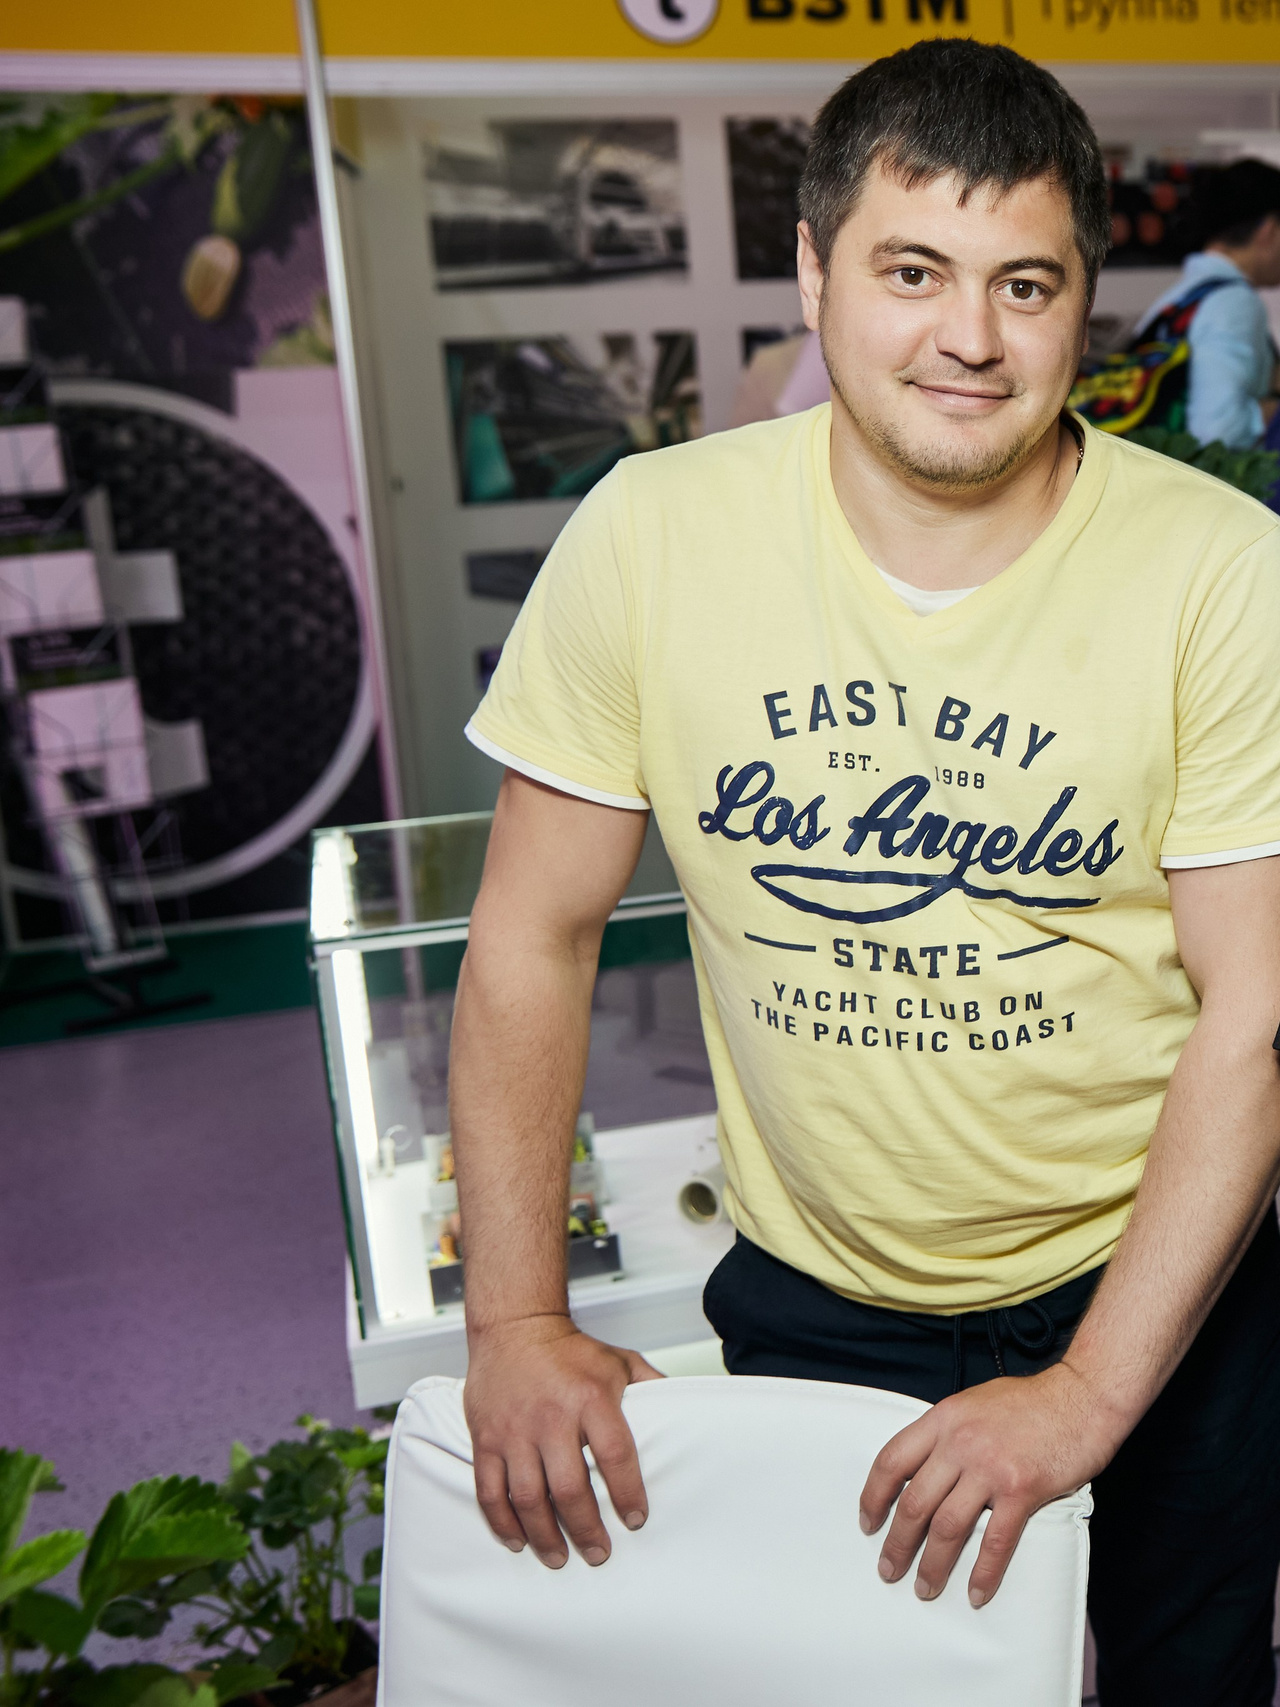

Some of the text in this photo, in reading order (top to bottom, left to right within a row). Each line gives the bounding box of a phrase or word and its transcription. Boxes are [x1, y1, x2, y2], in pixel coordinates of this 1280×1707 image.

[763, 680, 1057, 771] EAST BAY
[827, 751, 986, 790] EST. 1988
[698, 760, 1125, 886] Los Angeles
[832, 937, 982, 980] STATE
[750, 998, 1076, 1053] THE PACIFIC COAST
[772, 981, 1045, 1023] YACHT CLUB ON
